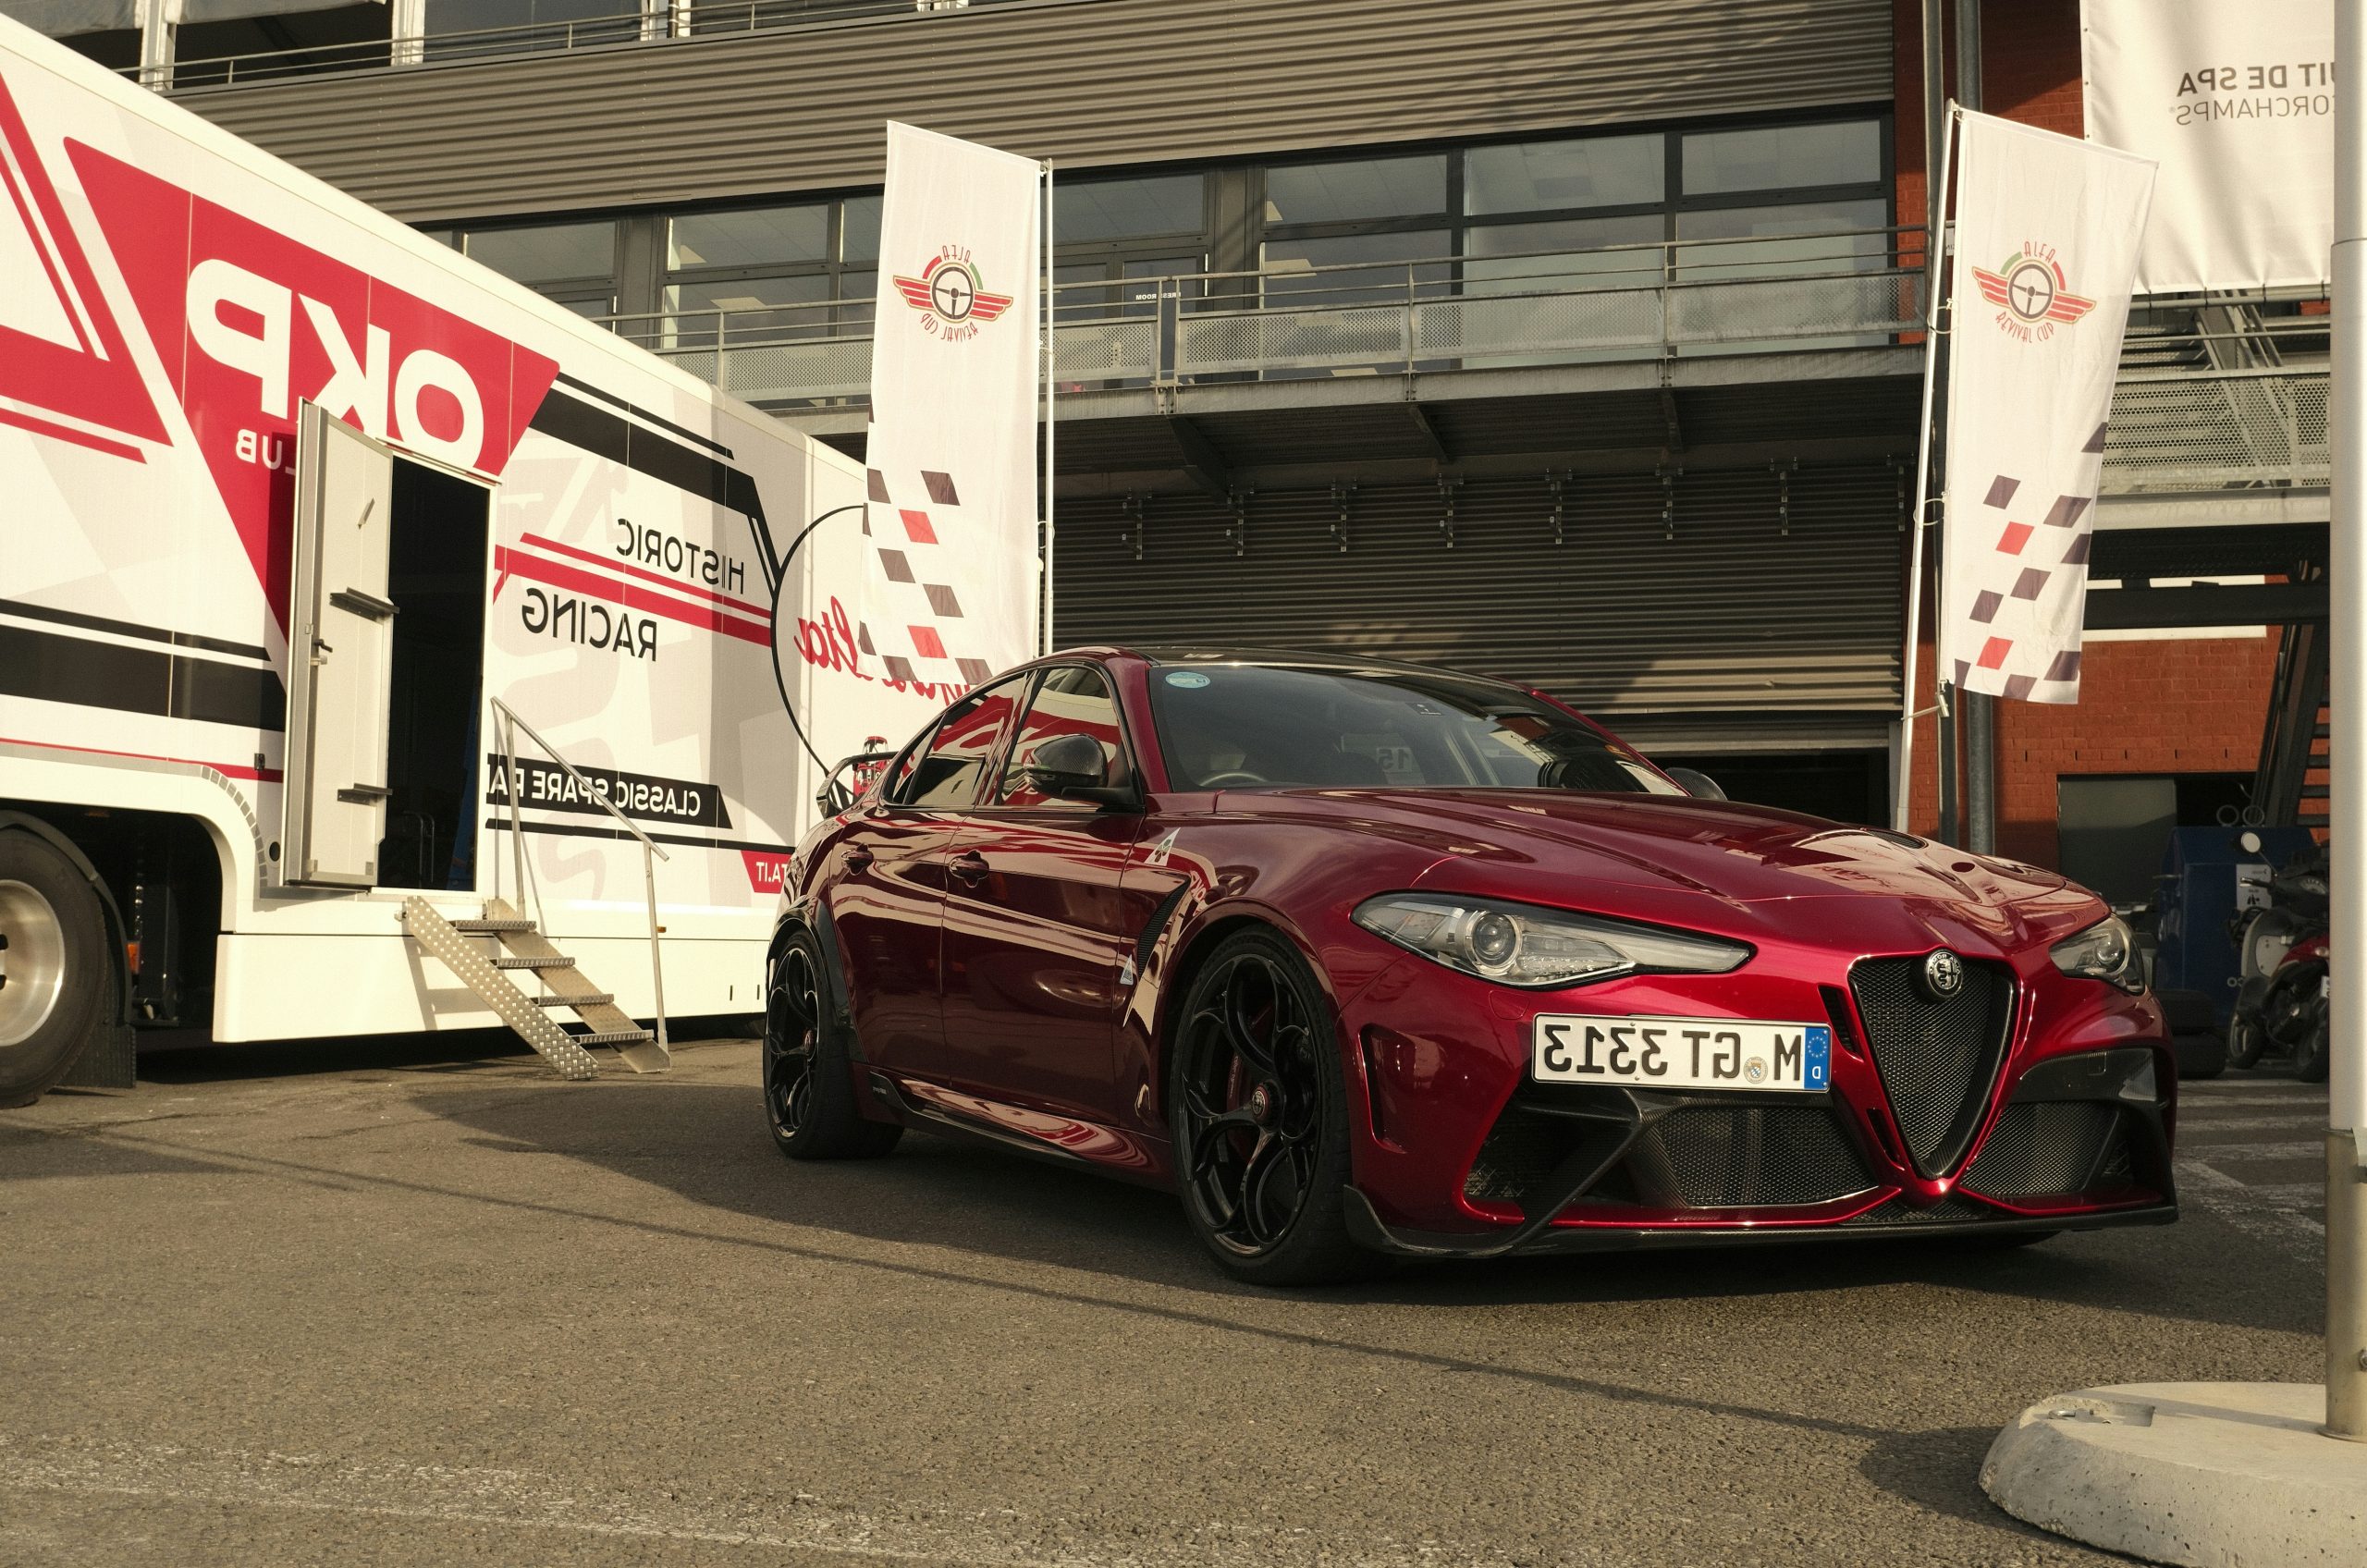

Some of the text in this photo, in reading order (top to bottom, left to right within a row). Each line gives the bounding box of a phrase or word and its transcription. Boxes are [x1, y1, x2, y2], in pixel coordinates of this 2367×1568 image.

[2024, 240, 2056, 263] ALFA
[1995, 311, 2054, 343] REVIVAL CUP
